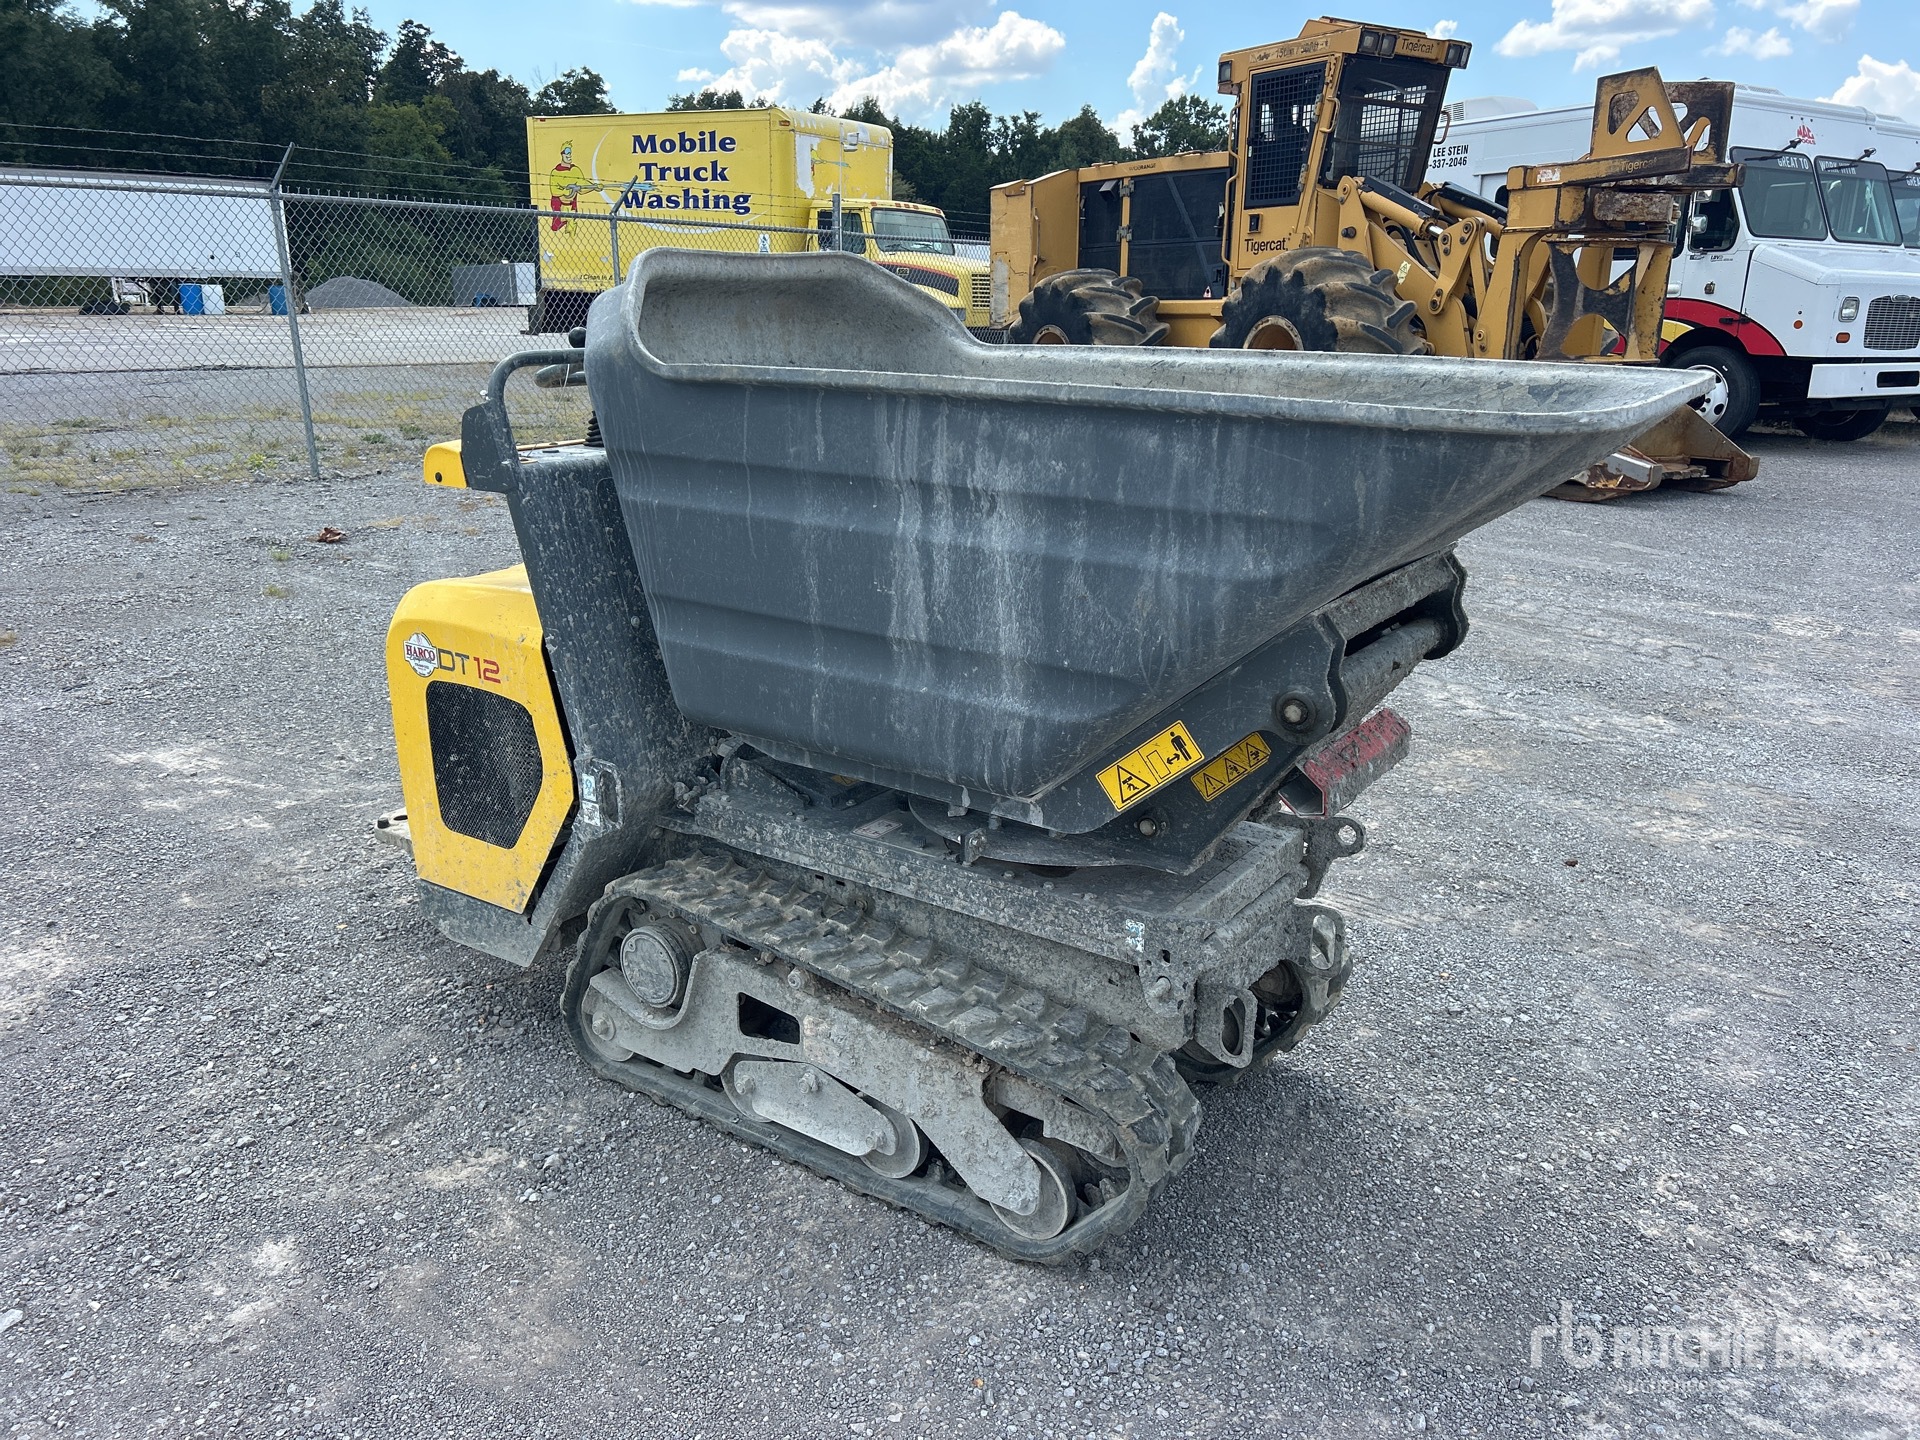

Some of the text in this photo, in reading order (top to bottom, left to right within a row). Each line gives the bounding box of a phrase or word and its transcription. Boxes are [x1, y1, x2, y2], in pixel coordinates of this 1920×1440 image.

[1401, 38, 1435, 54] Tigercat
[632, 129, 736, 154] Mobile
[1433, 144, 1469, 158] LEE STEIN
[639, 159, 729, 182] Truck
[1777, 156, 1810, 170] GREAT TO
[619, 187, 752, 215] Washing
[1244, 237, 1287, 255] Tigercat
[437, 647, 502, 684] DT12
